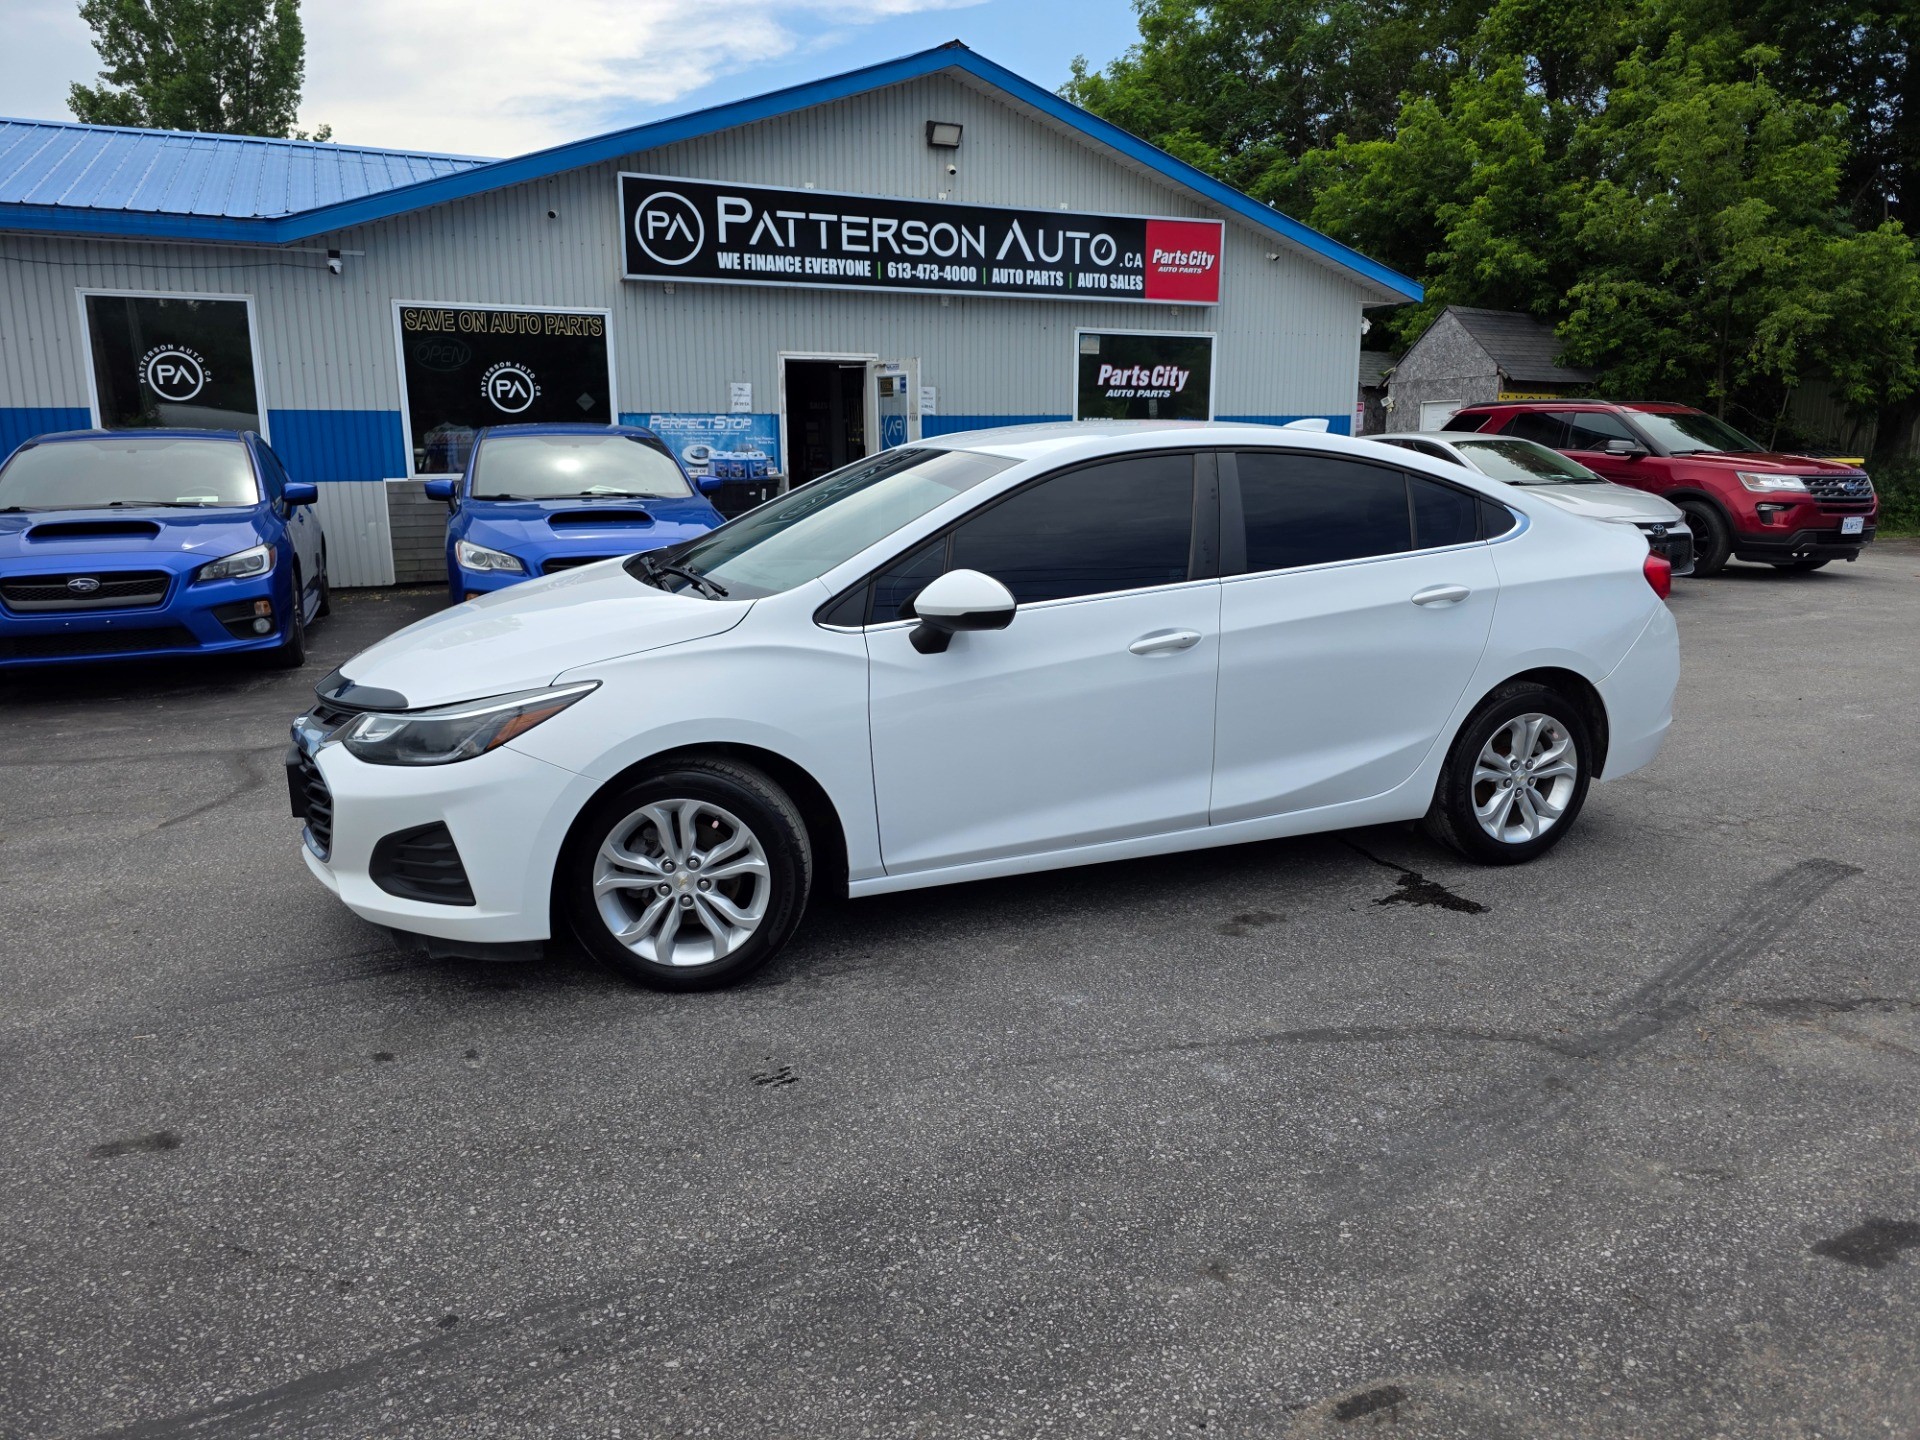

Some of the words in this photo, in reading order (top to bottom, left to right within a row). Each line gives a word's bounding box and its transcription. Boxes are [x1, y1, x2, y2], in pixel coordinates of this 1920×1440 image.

[647, 210, 694, 242] PA
[717, 195, 985, 259] PATTERSON
[717, 251, 741, 270] WE
[744, 253, 802, 274] FINANCE
[805, 257, 871, 277] EVERYONE
[1152, 249, 1215, 270] PartsCity
[887, 262, 977, 282] 613-473-4000
[992, 268, 1023, 285] AUTO
[1026, 269, 1064, 287] PARTS
[1077, 272, 1107, 289] AUTO
[1109, 275, 1143, 291] SALES
[404, 309, 455, 331] SAVE
[459, 311, 487, 332] ON
[490, 313, 541, 334] AUTO
[545, 314, 603, 336] PARTS
[140, 344, 174, 384] PATTERSON
[179, 345, 204, 363] AUTO
[417, 345, 466, 363] OPEN
[156, 364, 196, 385] PA
[481, 361, 511, 397] PATTERSON
[515, 362, 536, 379] AUTO
[1097, 364, 1189, 392] PartsCity
[495, 380, 528, 398] PA
[1105, 389, 1134, 398] AUTO
[1136, 389, 1171, 398] PARTS
[649, 415, 752, 429] PERFECTSTOP
